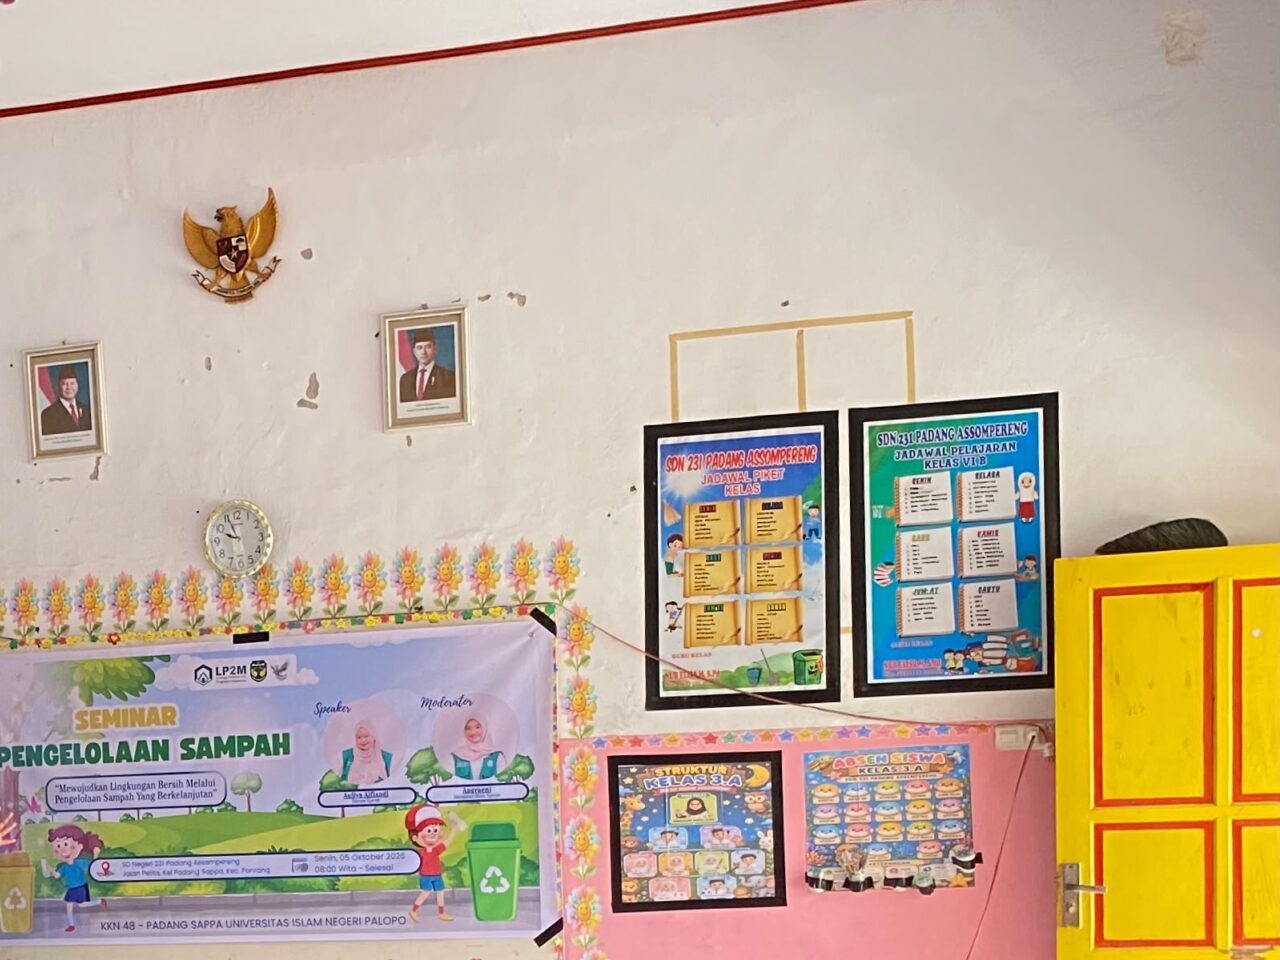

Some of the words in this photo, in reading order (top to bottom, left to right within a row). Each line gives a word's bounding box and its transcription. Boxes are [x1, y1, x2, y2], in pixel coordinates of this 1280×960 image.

[877, 432, 896, 447] SDN
[898, 433, 914, 446] 231
[916, 426, 954, 444] PADANG
[958, 422, 1028, 440] ASSOMPERENG
[894, 448, 947, 460] JADAWAL
[952, 442, 1016, 456] PELAJARAN
[666, 456, 684, 472] SDN
[688, 454, 703, 470] 231
[705, 450, 744, 470] PADANG
[746, 444, 818, 466] ASSOMPERENG
[924, 458, 960, 470] KELAS
[964, 457, 976, 466] VI
[978, 456, 988, 466] B
[702, 472, 752, 484] JADAWAL
[754, 468, 785, 482] PIKET
[724, 484, 761, 496] KELAS
[233, 510, 241, 520] 12
[253, 520, 260, 528] 2
[214, 537, 220, 546] 9
[258, 532, 264, 541] 3
[219, 550, 226, 558] 8
[255, 546, 261, 554] 4
[228, 556, 234, 566] 7
[238, 558, 244, 568] 6
[248, 555, 254, 564] 5
[216, 665, 247, 676] LP2M
[420, 694, 474, 709] Moderator
[313, 700, 352, 718] Speaker
[74, 706, 178, 731] SEMINAR
[180, 732, 291, 760] SAMPAH
[833, 754, 889, 769] ABSEN
[890, 752, 946, 764] SISWA
[655, 766, 728, 777] STRUKTUR
[858, 766, 898, 774] KELAS
[110, 780, 156, 794] Lingkungan
[158, 780, 184, 790] Bersih
[186, 778, 216, 788] Melalui
[644, 775, 708, 790] KELAS
[712, 774, 743, 787] 3.A
[55, 793, 102, 804] Pengelolaan
[103, 792, 135, 803] Sampah
[136, 790, 156, 802] Yang
[351, 853, 384, 862] Oktober
[174, 868, 200, 877] Padang
[338, 864, 356, 872] Wita
[364, 864, 394, 872] Selesai
[100, 922, 120, 930] KKN
[122, 921, 136, 930] 48
[146, 920, 188, 930] PADANG
[190, 920, 222, 929] SAPPA
[225, 918, 290, 928] UNIVERSITAS
[292, 918, 322, 928] ISLAM
[325, 917, 362, 926] NEGERI
[364, 916, 406, 926] PALOPO
